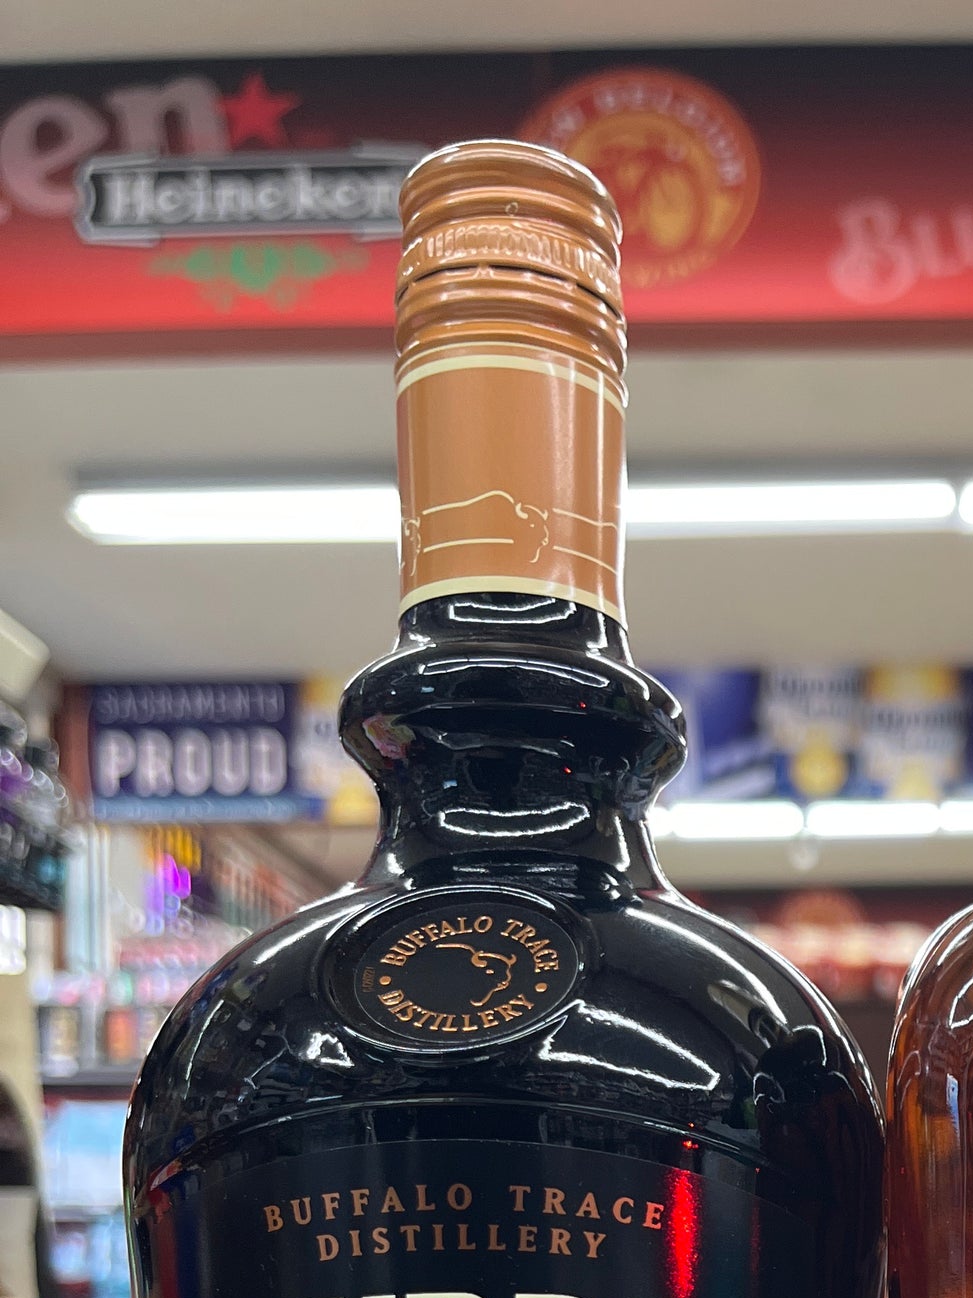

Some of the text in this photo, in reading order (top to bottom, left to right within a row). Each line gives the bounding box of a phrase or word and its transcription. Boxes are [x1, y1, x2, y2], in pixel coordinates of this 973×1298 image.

[0, 77, 230, 218] en
[96, 727, 288, 798] PROUD
[380, 915, 560, 973] BUFFALO TRACE
[378, 993, 535, 1032] DISTILLERY
[264, 1184, 665, 1232] BUFFALO TRACE
[316, 1224, 607, 1261] DISTILLERY
